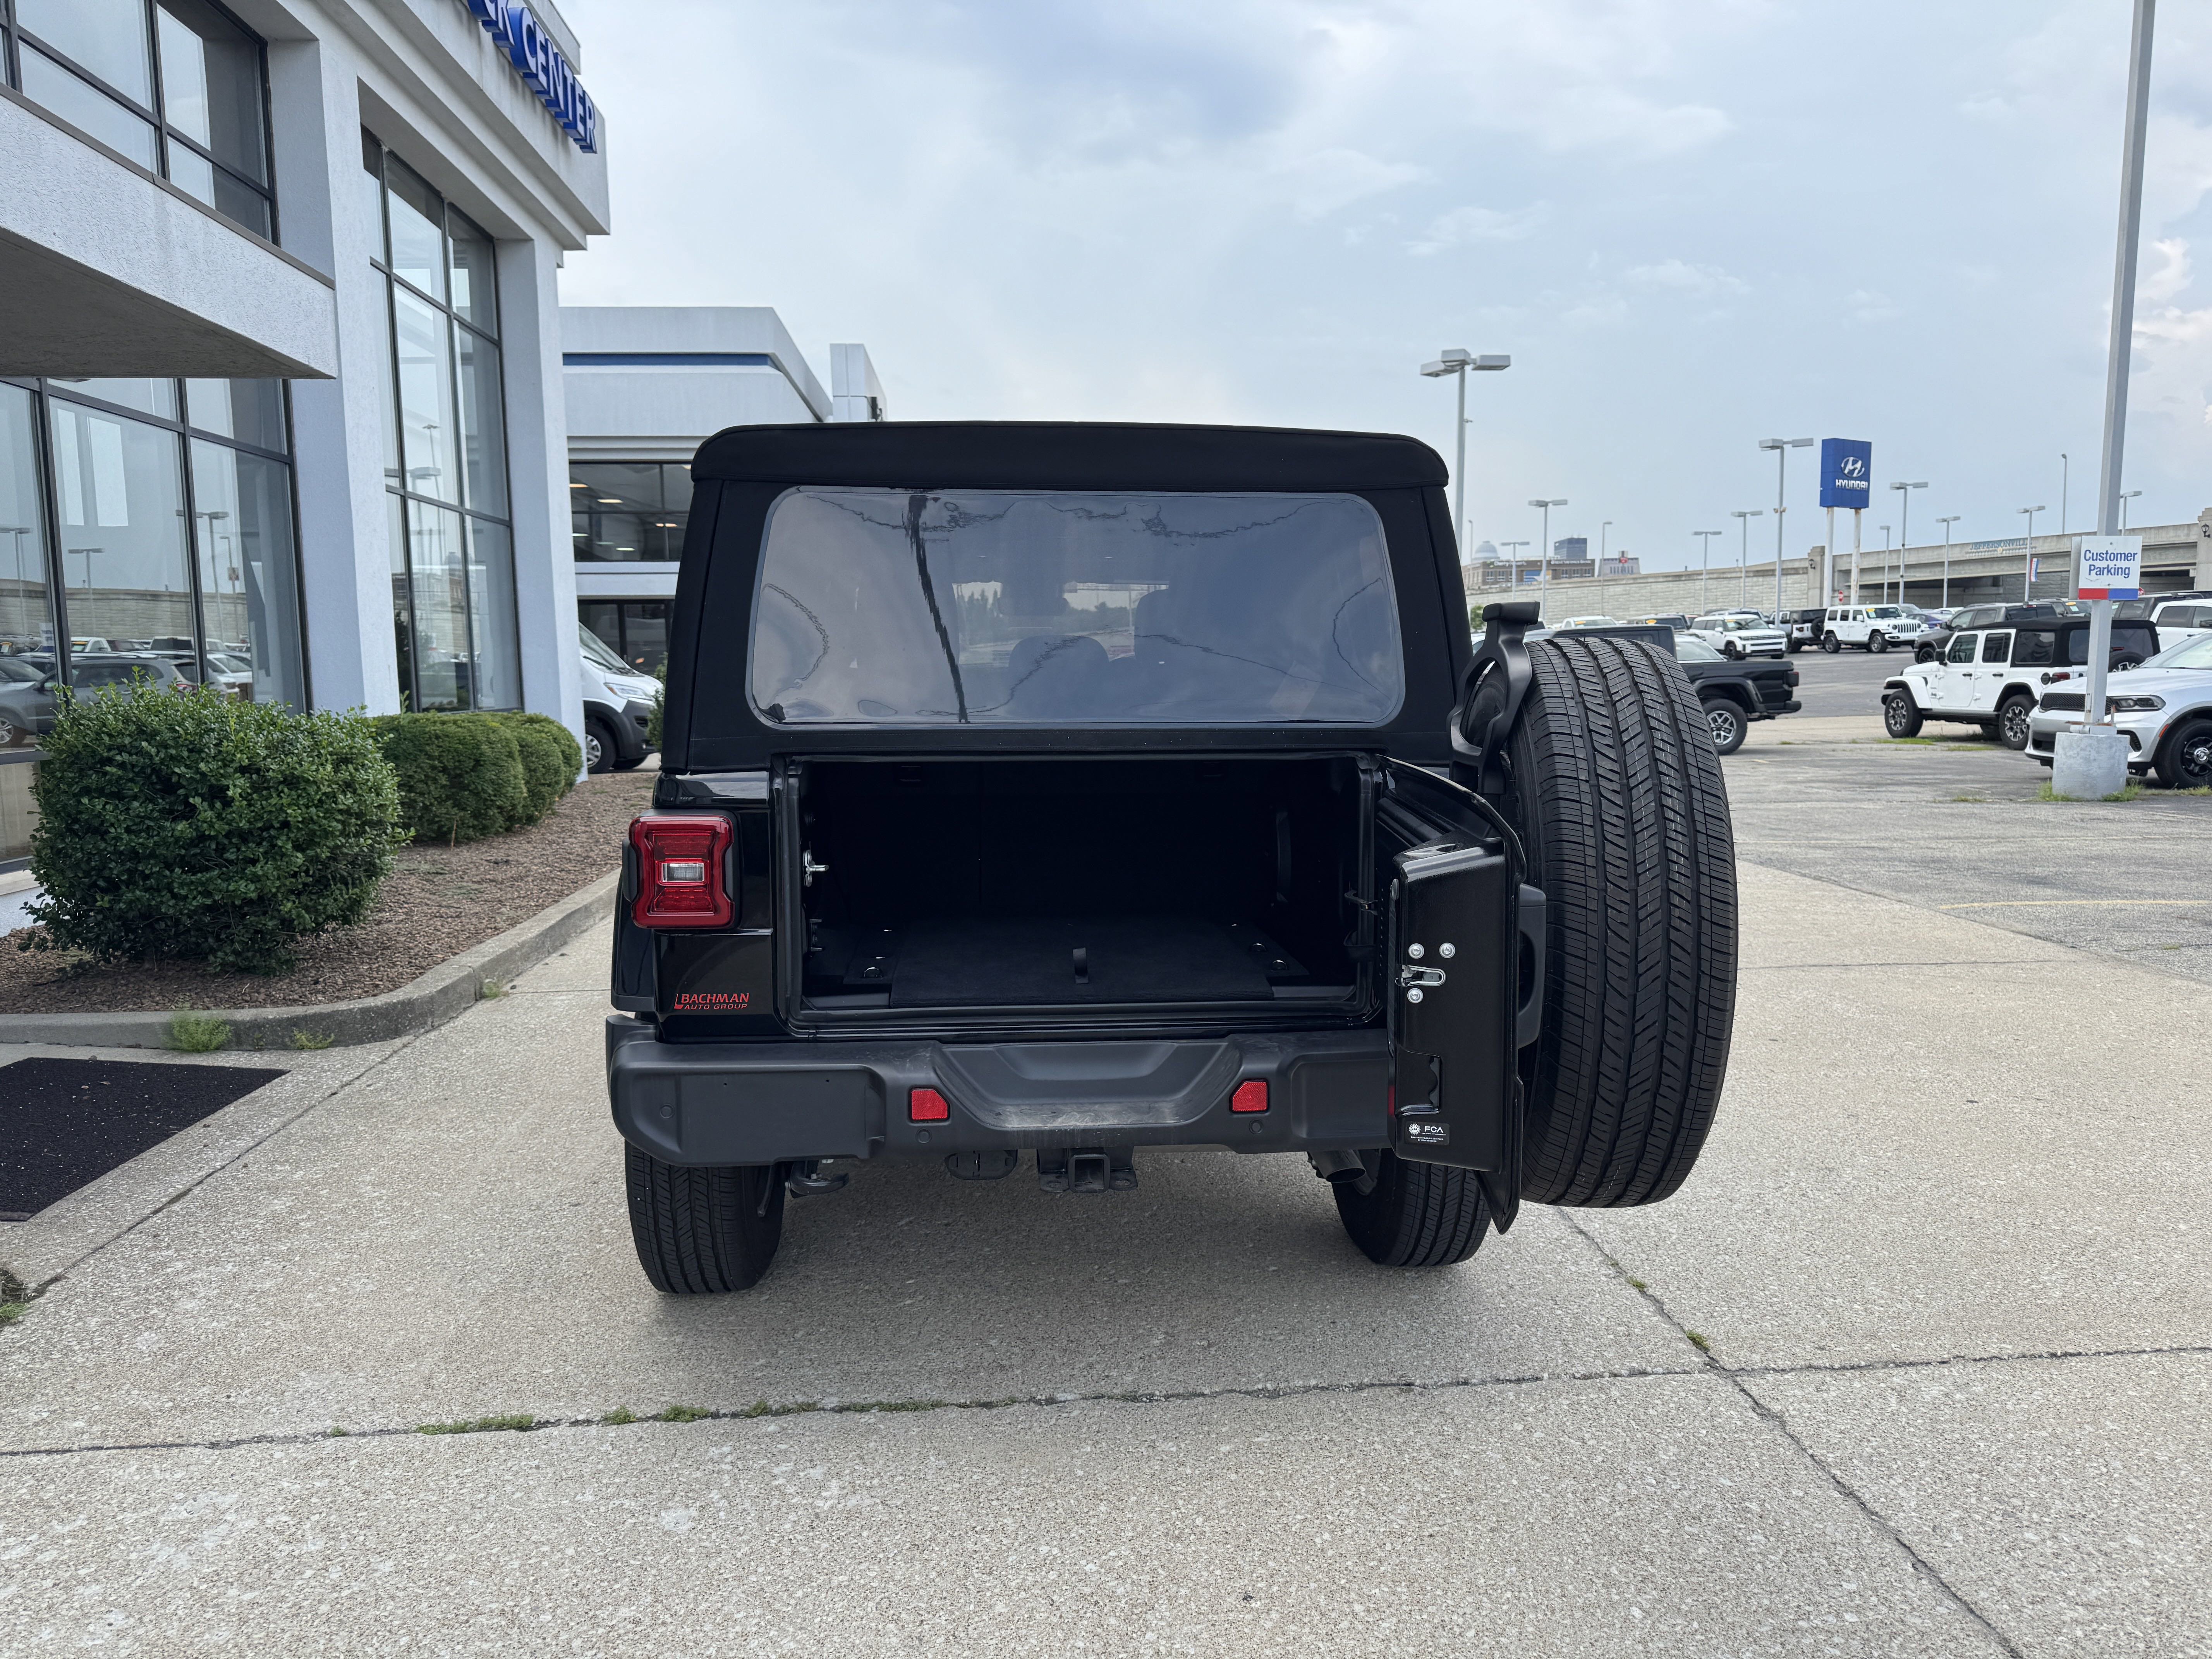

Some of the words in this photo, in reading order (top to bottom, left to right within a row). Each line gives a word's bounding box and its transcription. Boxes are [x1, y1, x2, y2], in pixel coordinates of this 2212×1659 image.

[512, 7, 597, 154] CENTER
[1836, 479, 1868, 490] HYUNDAI
[1970, 538, 2032, 550] JEFFERSONVILL
[2084, 549, 2138, 562] Customer
[2088, 564, 2131, 579] Parking
[681, 993, 749, 1003] BACHMAN
